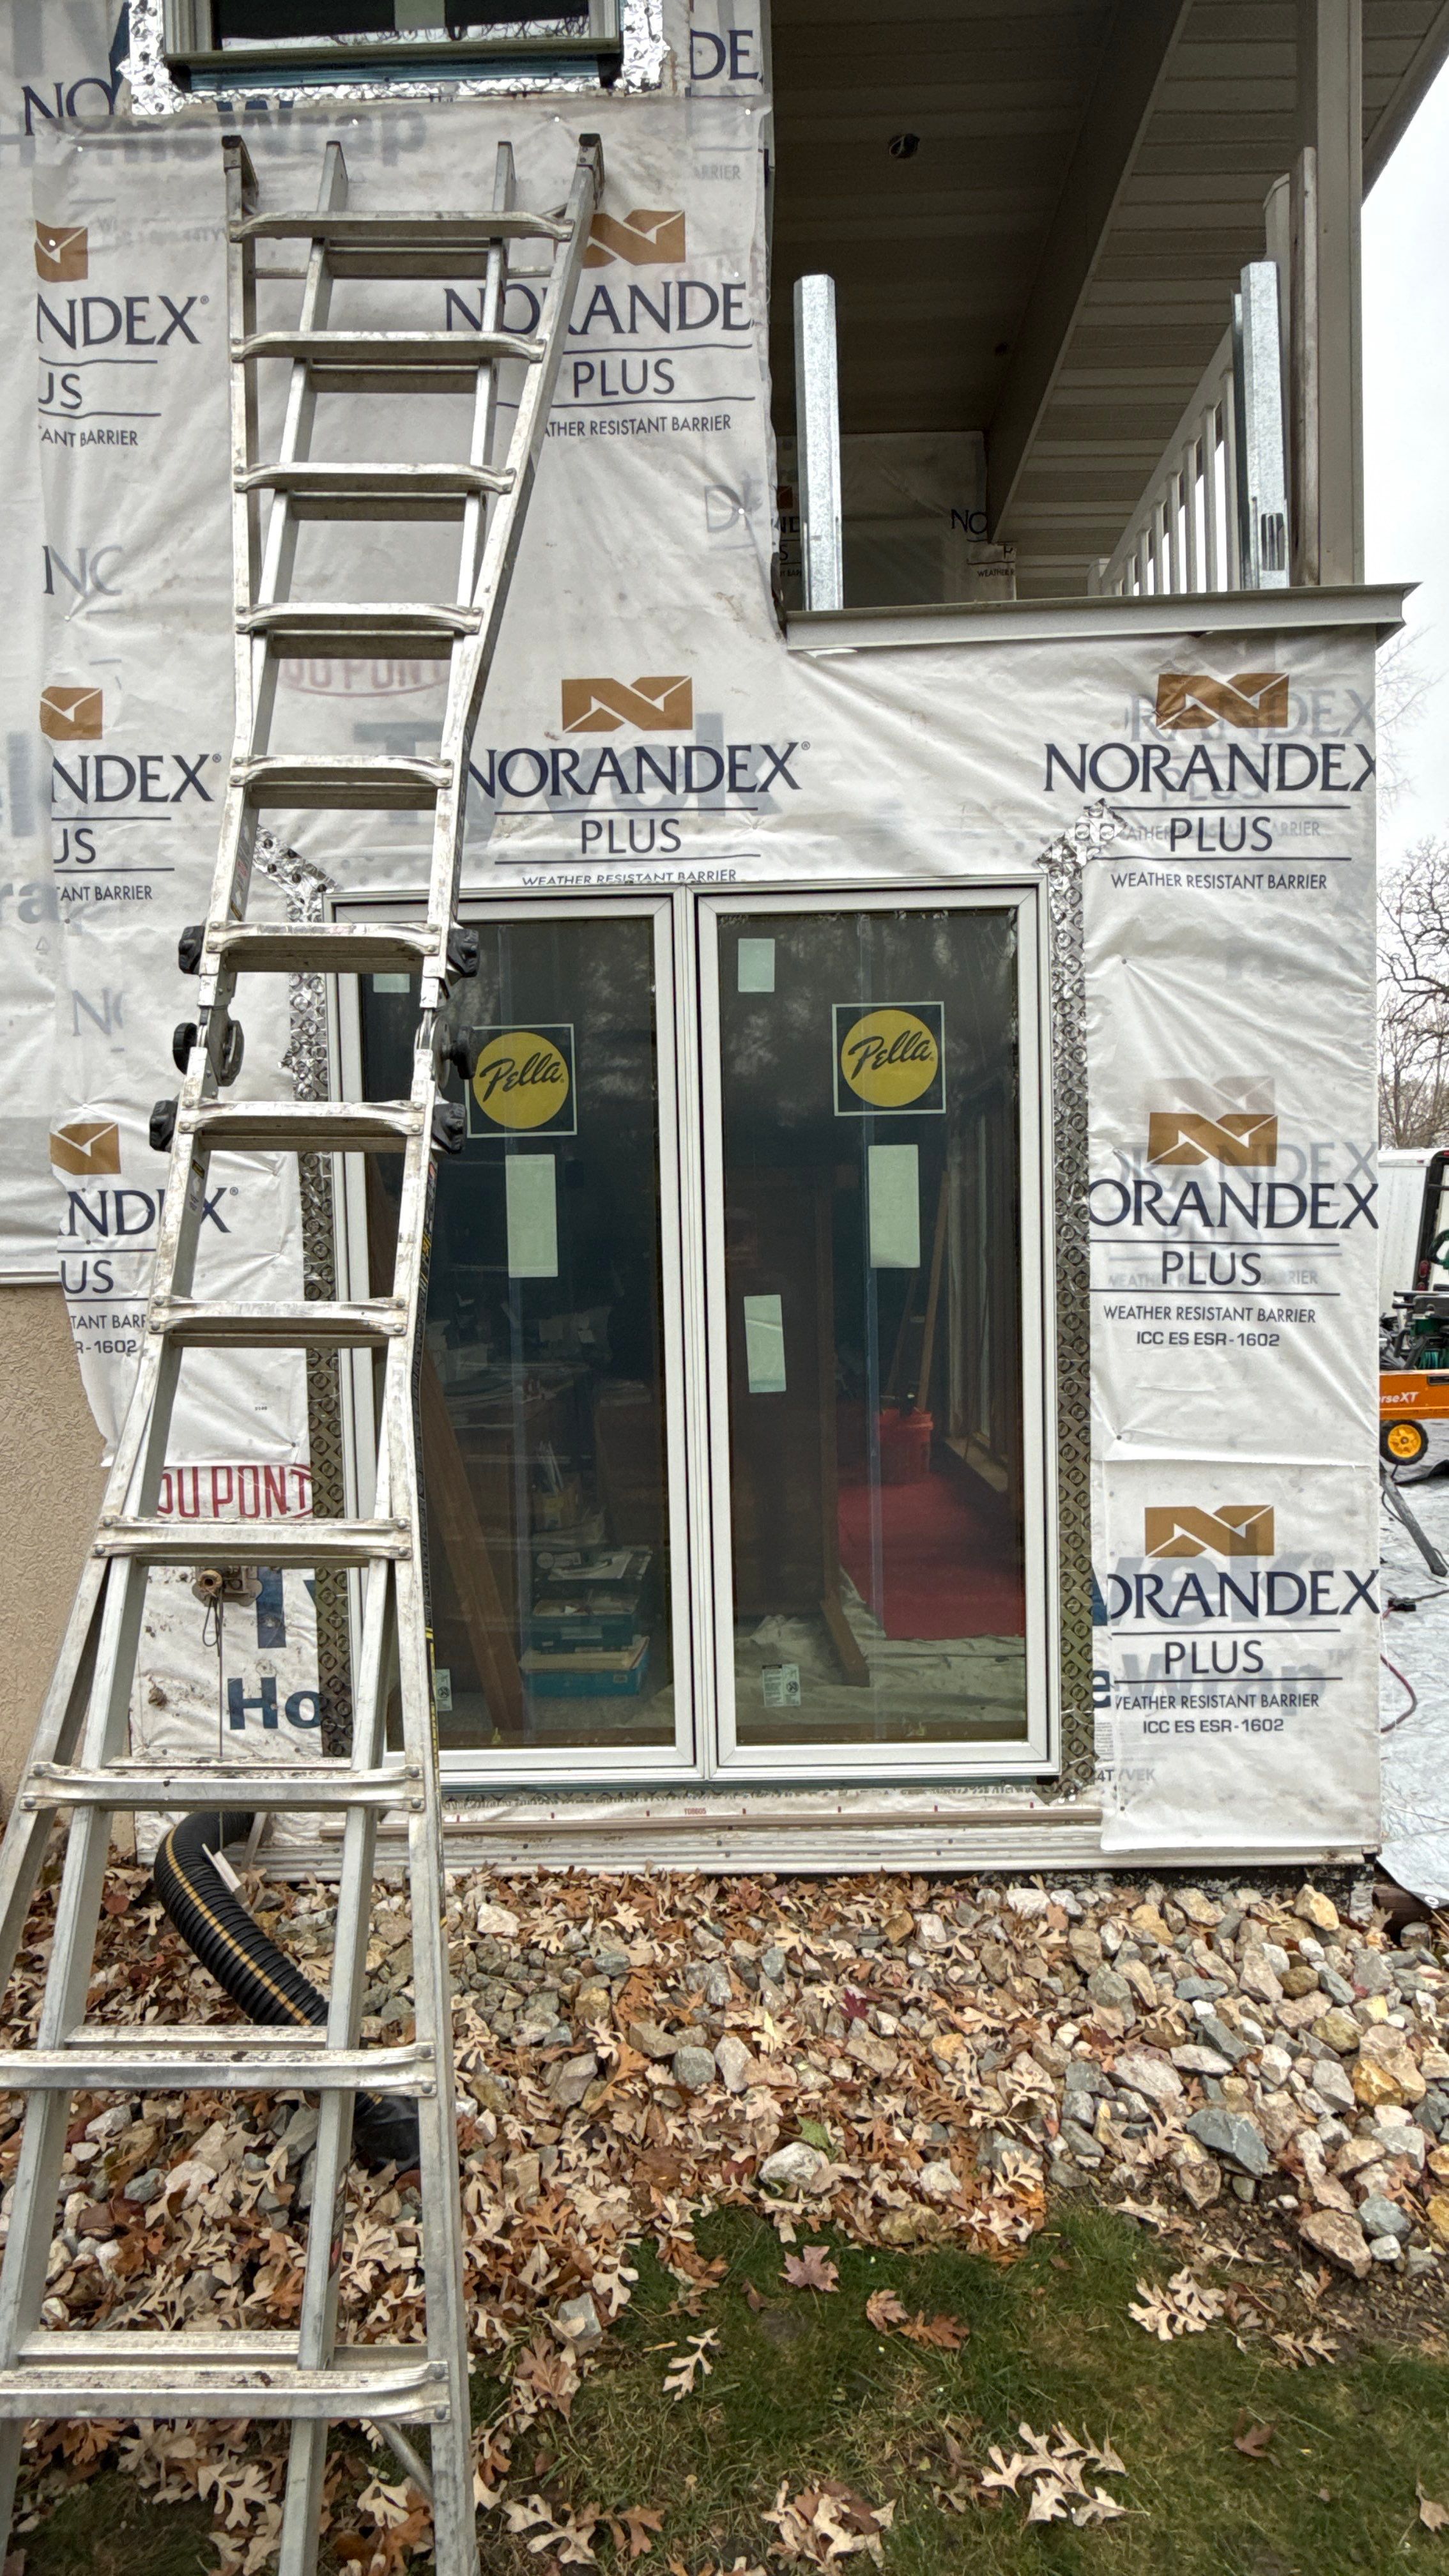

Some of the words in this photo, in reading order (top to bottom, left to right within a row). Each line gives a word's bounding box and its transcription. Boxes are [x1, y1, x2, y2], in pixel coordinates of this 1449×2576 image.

[574, 358, 675, 397] PLUS
[39, 429, 75, 447] ANT
[80, 429, 139, 447] BARRIER
[590, 417, 667, 437] RESISTANT
[671, 414, 732, 433] BARRIER
[468, 741, 802, 798] NORANDEX
[1044, 742, 1376, 793] NORANDEX
[581, 818, 682, 854] PLUS
[1170, 816, 1273, 852] PLUS
[95, 884, 153, 901] BARRIER
[1110, 871, 1183, 889] WEATHER
[1186, 873, 1263, 890] RESISTANT
[1268, 873, 1327, 890] BARRIER
[848, 1029, 932, 1080] Pella
[479, 1052, 562, 1102] Pella
[60, 1187, 231, 1238] NDX
[1088, 1179, 1379, 1230] ORANDEX
[1162, 1250, 1262, 1286] PLUS
[1103, 1305, 1171, 1321] WEATHER
[1176, 1307, 1254, 1322] RESISTANT
[1257, 1308, 1316, 1324] BARRIER
[1136, 1331, 1164, 1346] ICC
[1169, 1331, 1190, 1346] ES
[1165, 1640, 1264, 1675] PLUS
[1181, 1694, 1257, 1709] RESISTANT
[1261, 1693, 1319, 1708] BARRIER
[1143, 1720, 1170, 1733] ICC
[1175, 1720, 1195, 1733] ES
